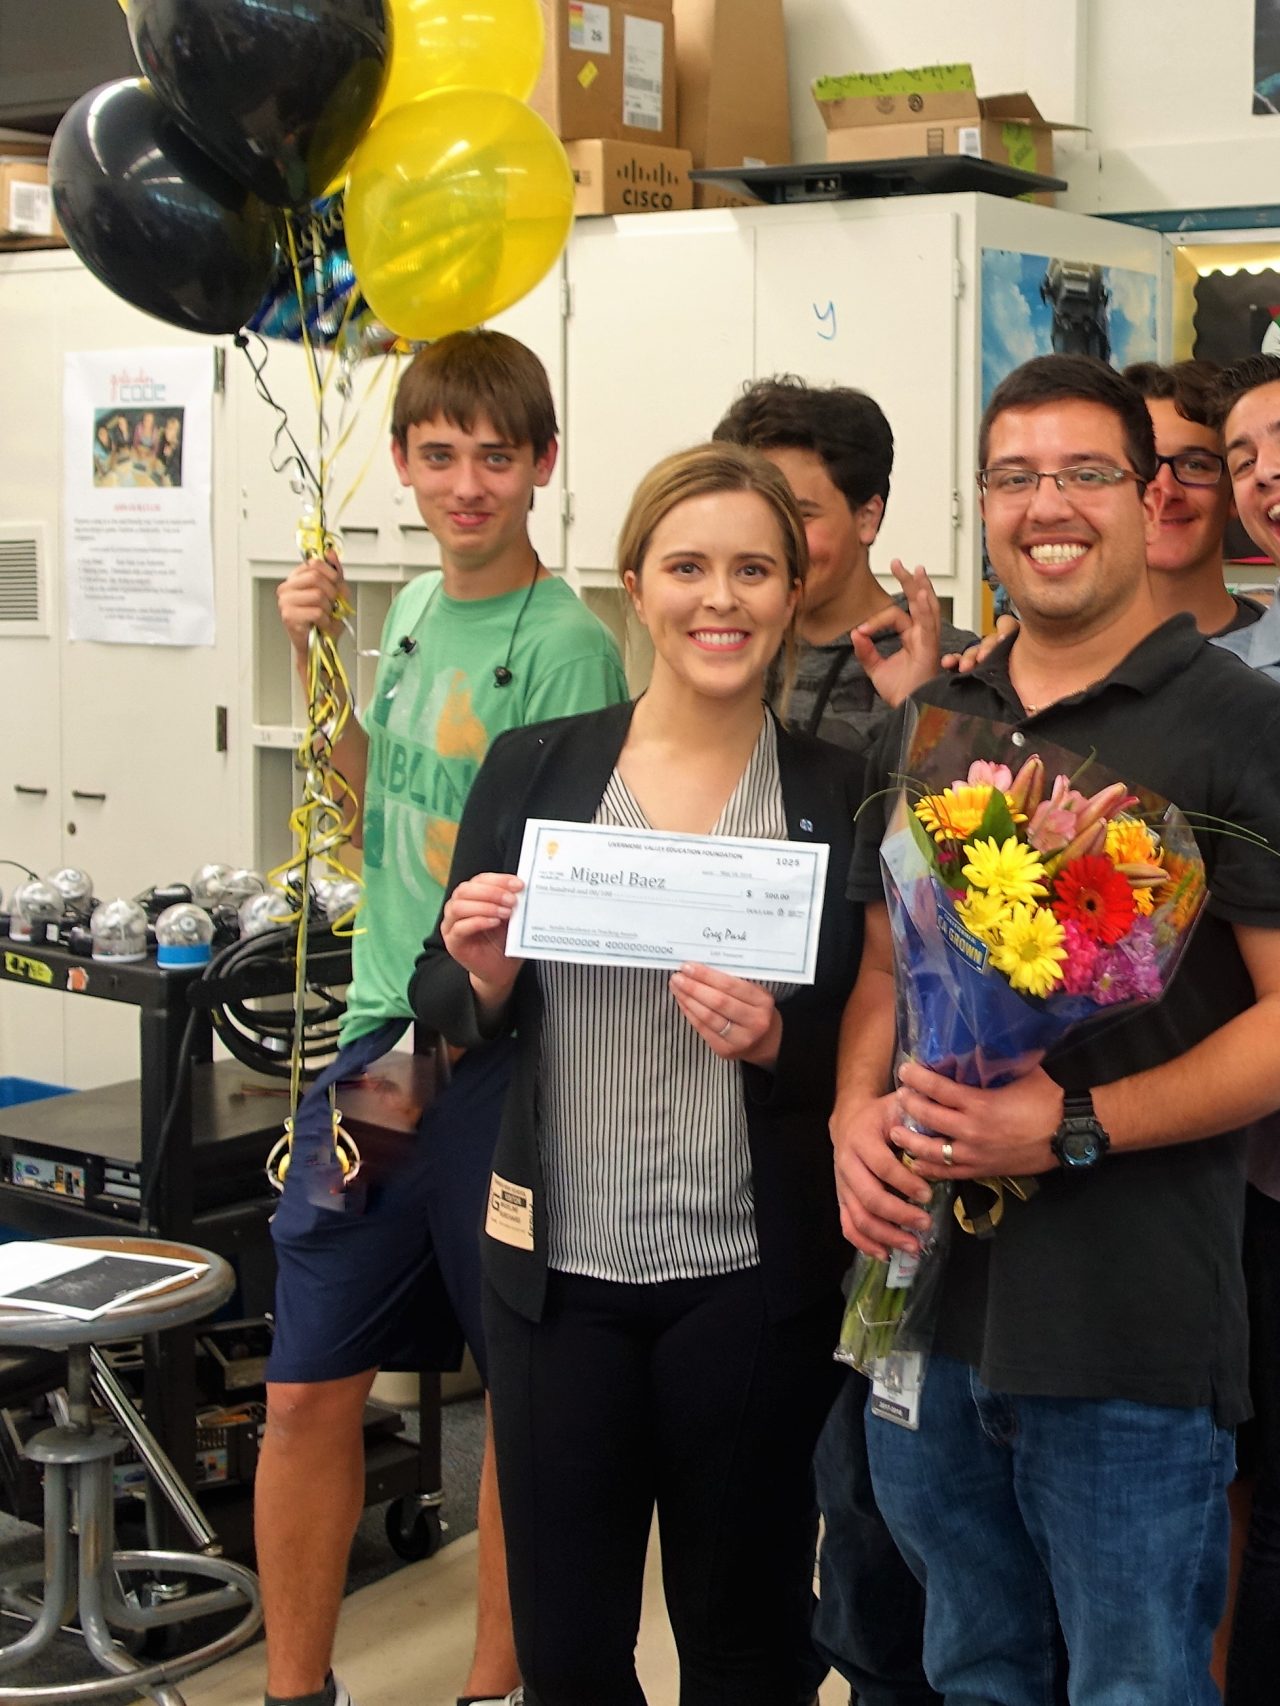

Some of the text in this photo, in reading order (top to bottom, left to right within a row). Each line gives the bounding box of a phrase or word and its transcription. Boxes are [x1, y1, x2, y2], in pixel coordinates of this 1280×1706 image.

[622, 188, 673, 210] CISCO
[665, 846, 701, 856] EDUCATION
[702, 849, 743, 860] FOUNDATION
[775, 857, 801, 867] 1025
[570, 866, 624, 886] Miguel
[628, 871, 666, 889] Baez
[746, 889, 752, 898] $
[948, 927, 983, 964] GROWN
